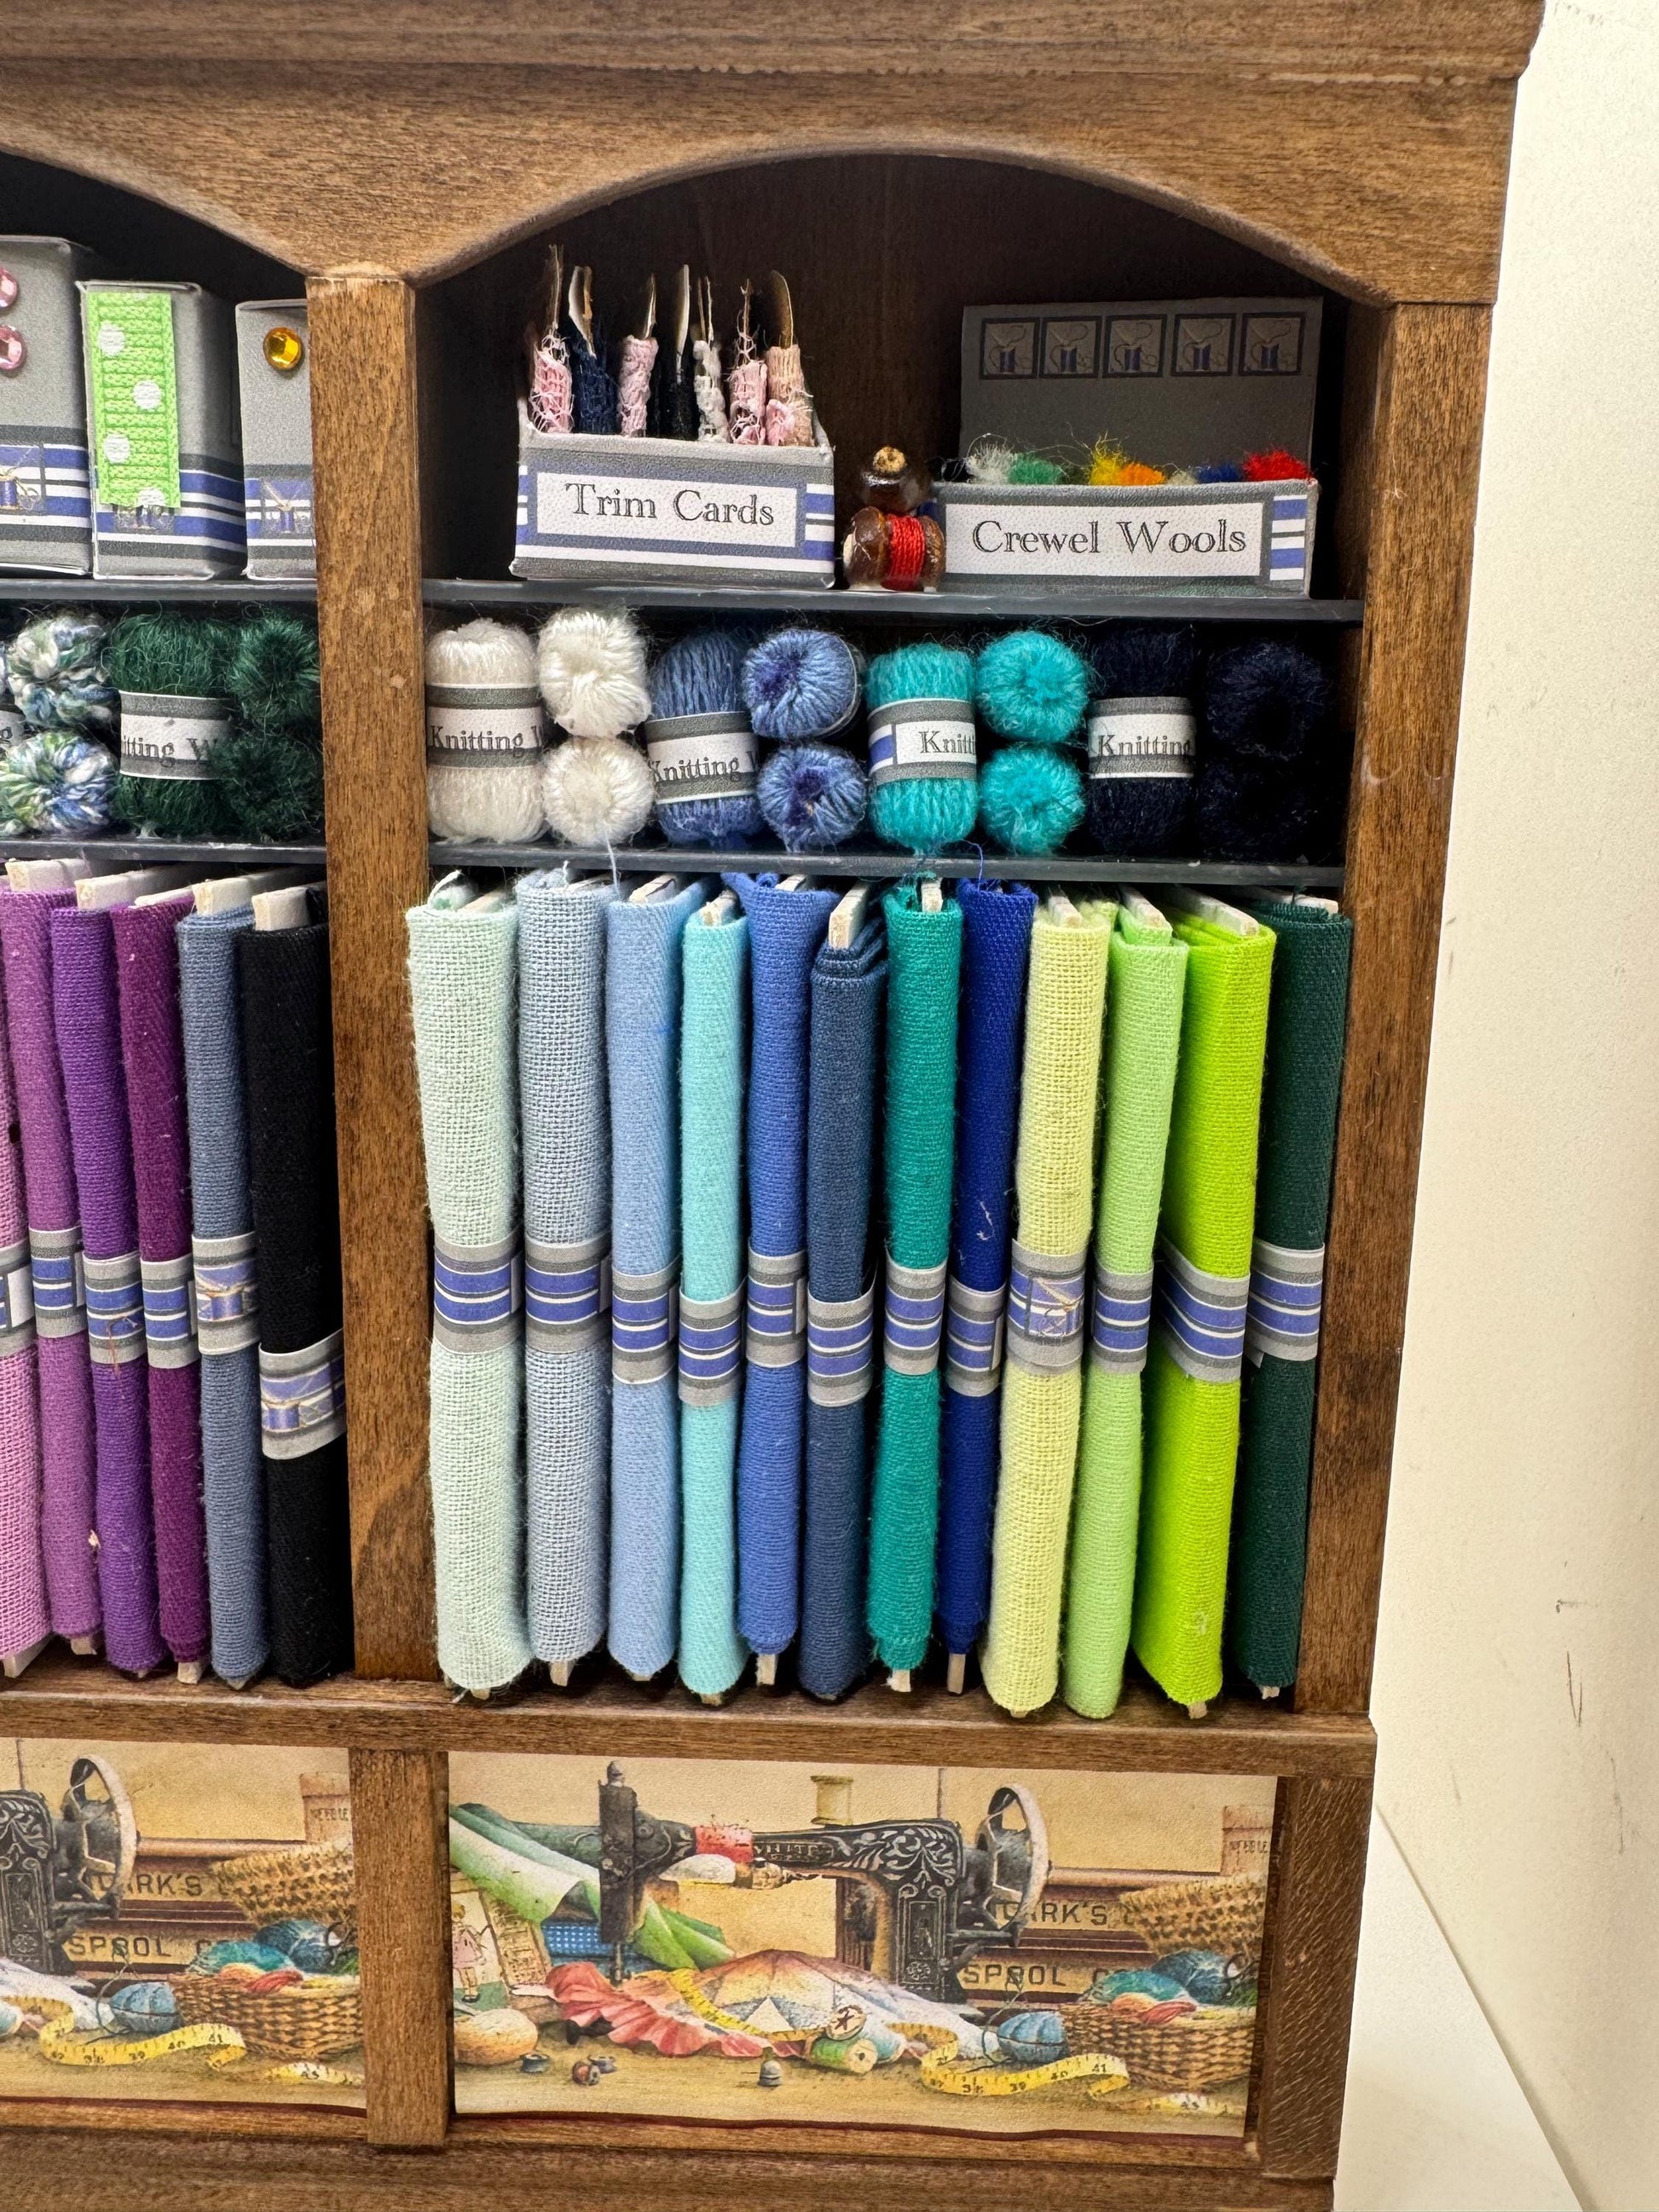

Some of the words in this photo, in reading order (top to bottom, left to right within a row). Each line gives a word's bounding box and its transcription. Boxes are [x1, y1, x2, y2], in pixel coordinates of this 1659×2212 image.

[565, 482, 656, 518] Trim
[673, 488, 775, 526] Cards
[973, 519, 1101, 554] Crewel
[1117, 518, 1247, 554] Wools
[431, 725, 524, 758] Knitting
